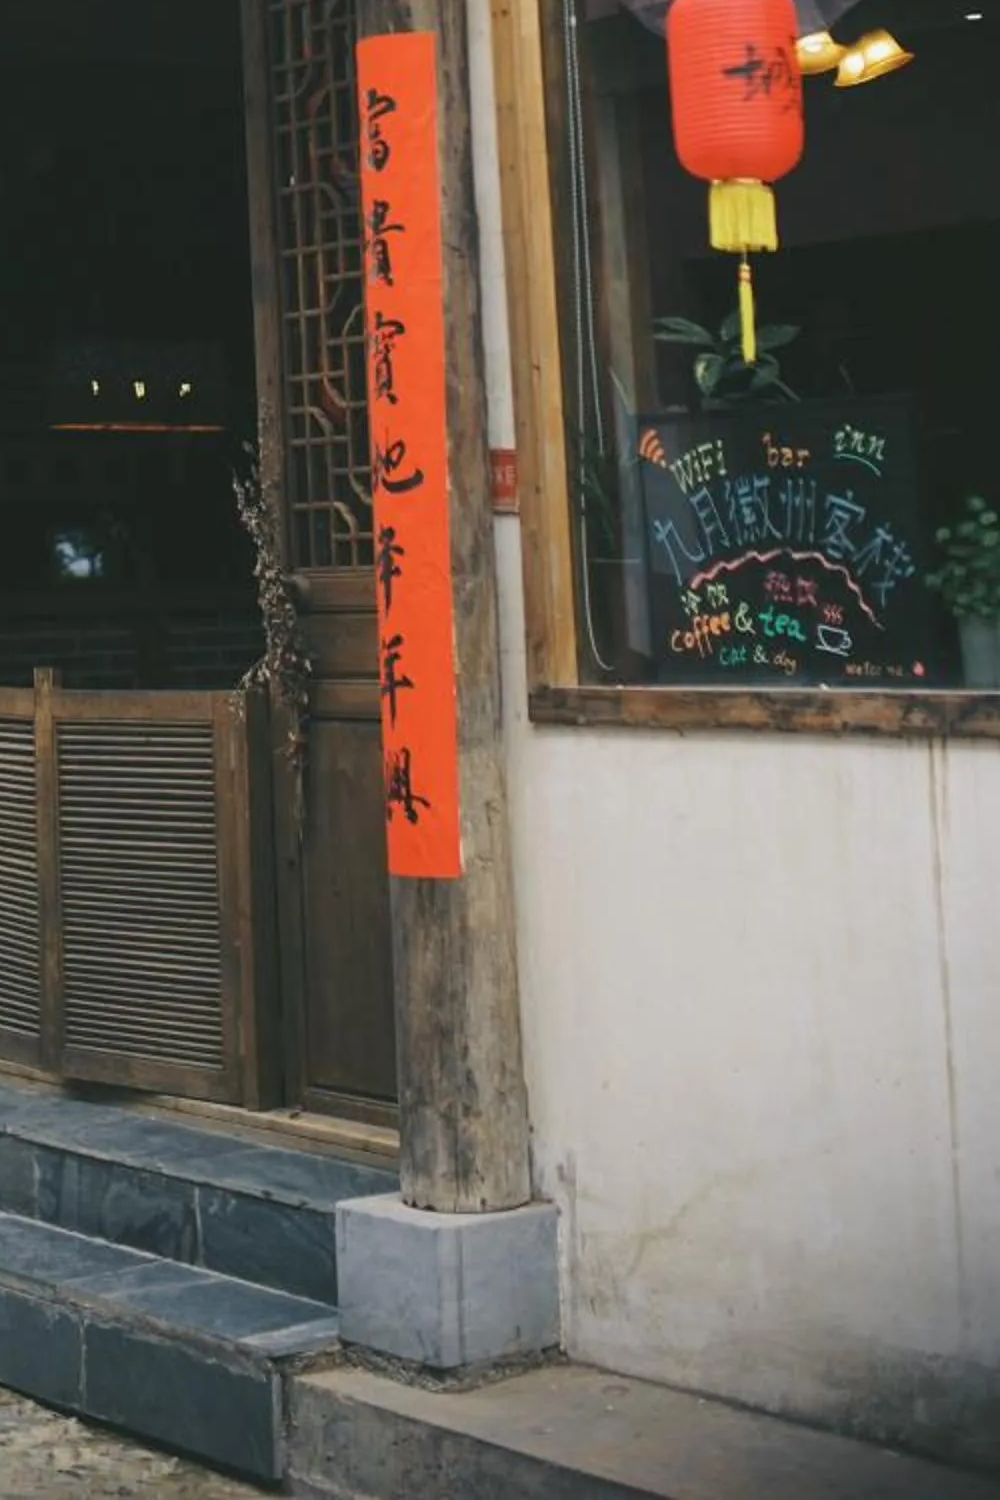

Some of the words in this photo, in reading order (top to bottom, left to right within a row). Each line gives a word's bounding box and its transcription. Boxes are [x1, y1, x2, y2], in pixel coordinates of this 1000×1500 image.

[762, 432, 810, 467] bar
[834, 425, 885, 461] inn
[735, 602, 755, 634] &
[759, 605, 807, 642] tea
[773, 652, 797, 676] dog
